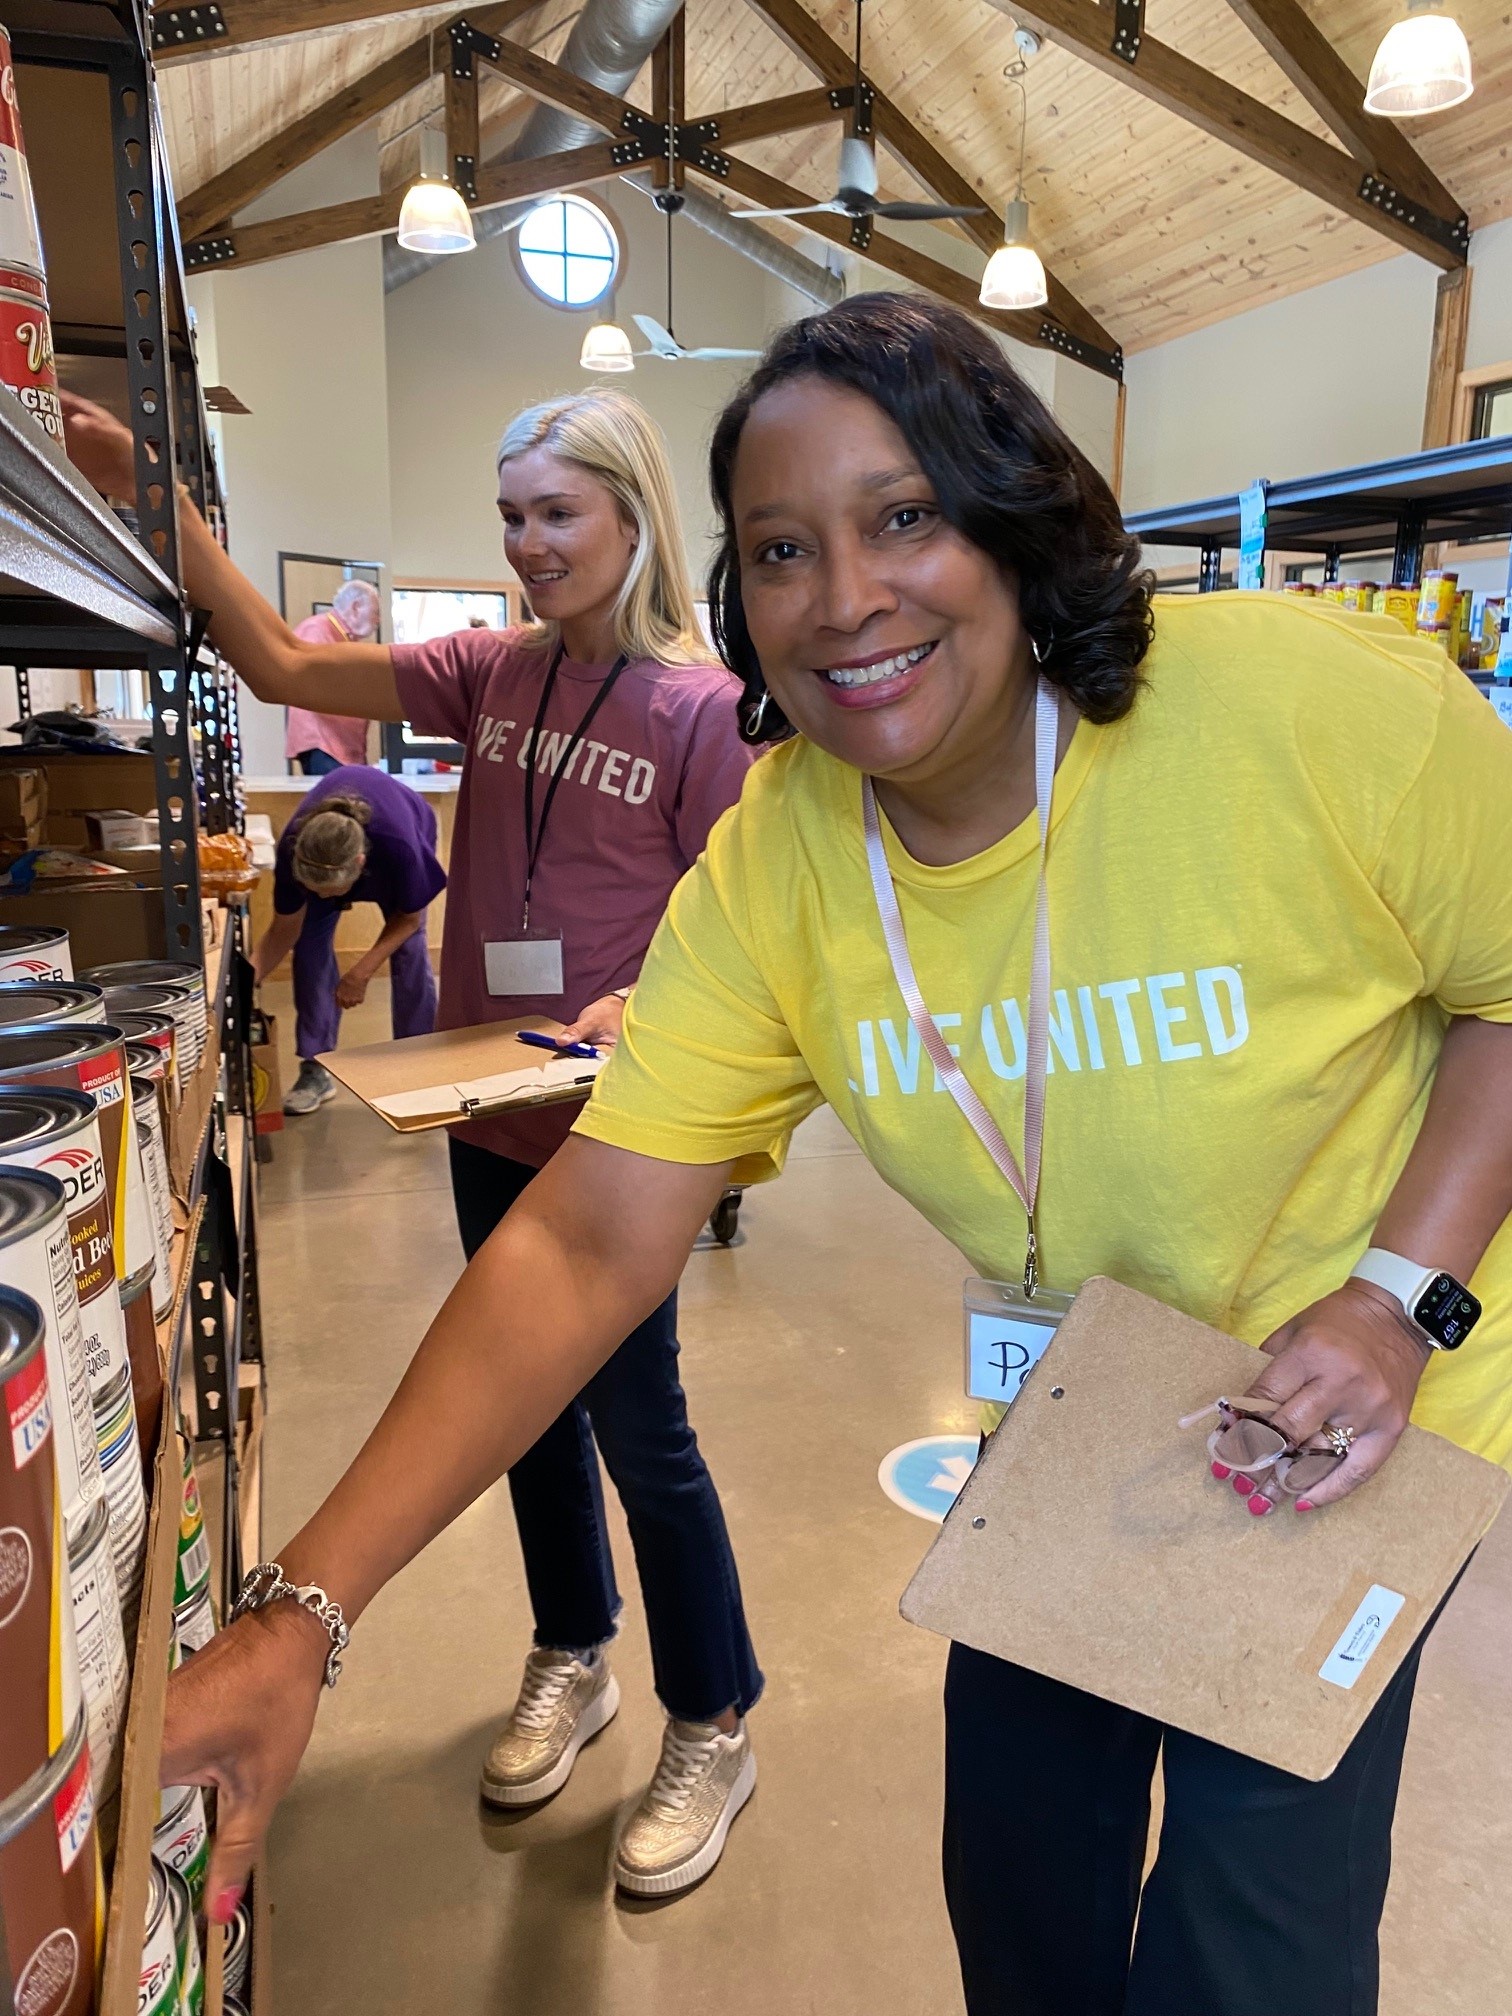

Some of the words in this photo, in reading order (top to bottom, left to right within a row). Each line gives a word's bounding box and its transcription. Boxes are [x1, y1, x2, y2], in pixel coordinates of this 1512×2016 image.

[516, 726, 657, 805] UNITED
[847, 1012, 963, 1098] IVE
[980, 965, 1250, 1081] UNITED
[82, 1071, 114, 1090] PRODUCT
[91, 1083, 121, 1107] USA
[62, 1156, 104, 1203] DER
[71, 1219, 99, 1245] ooked
[77, 1267, 102, 1291] uices
[172, 1822, 204, 1870] DER
[138, 1953, 172, 2014] DER
